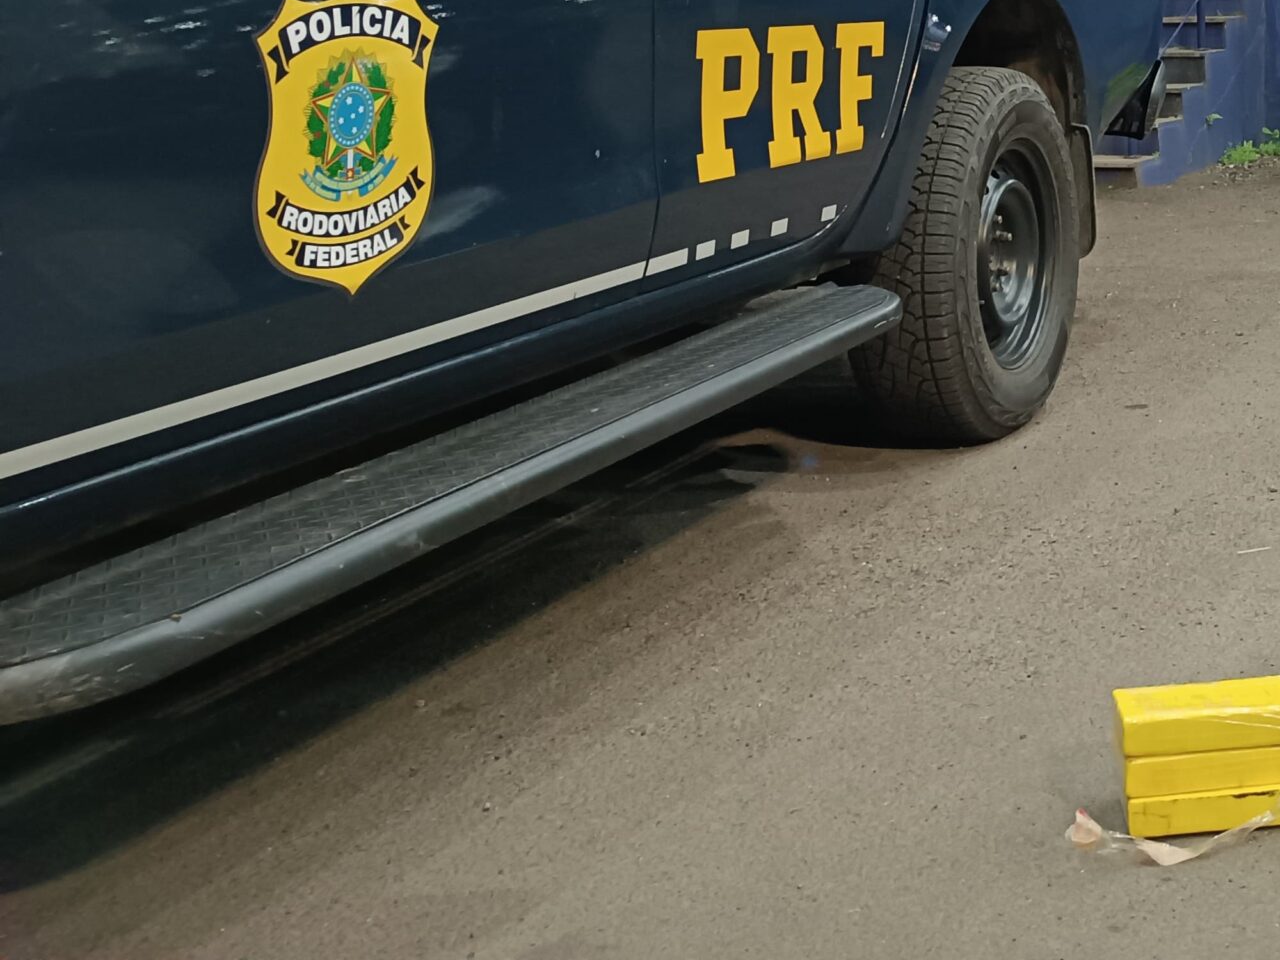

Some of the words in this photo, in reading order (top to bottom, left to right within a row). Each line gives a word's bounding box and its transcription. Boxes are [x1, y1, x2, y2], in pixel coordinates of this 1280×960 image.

[286, 5, 410, 55] POLÍCIA
[696, 21, 885, 184] PRF
[303, 228, 398, 268] FEDERAL
